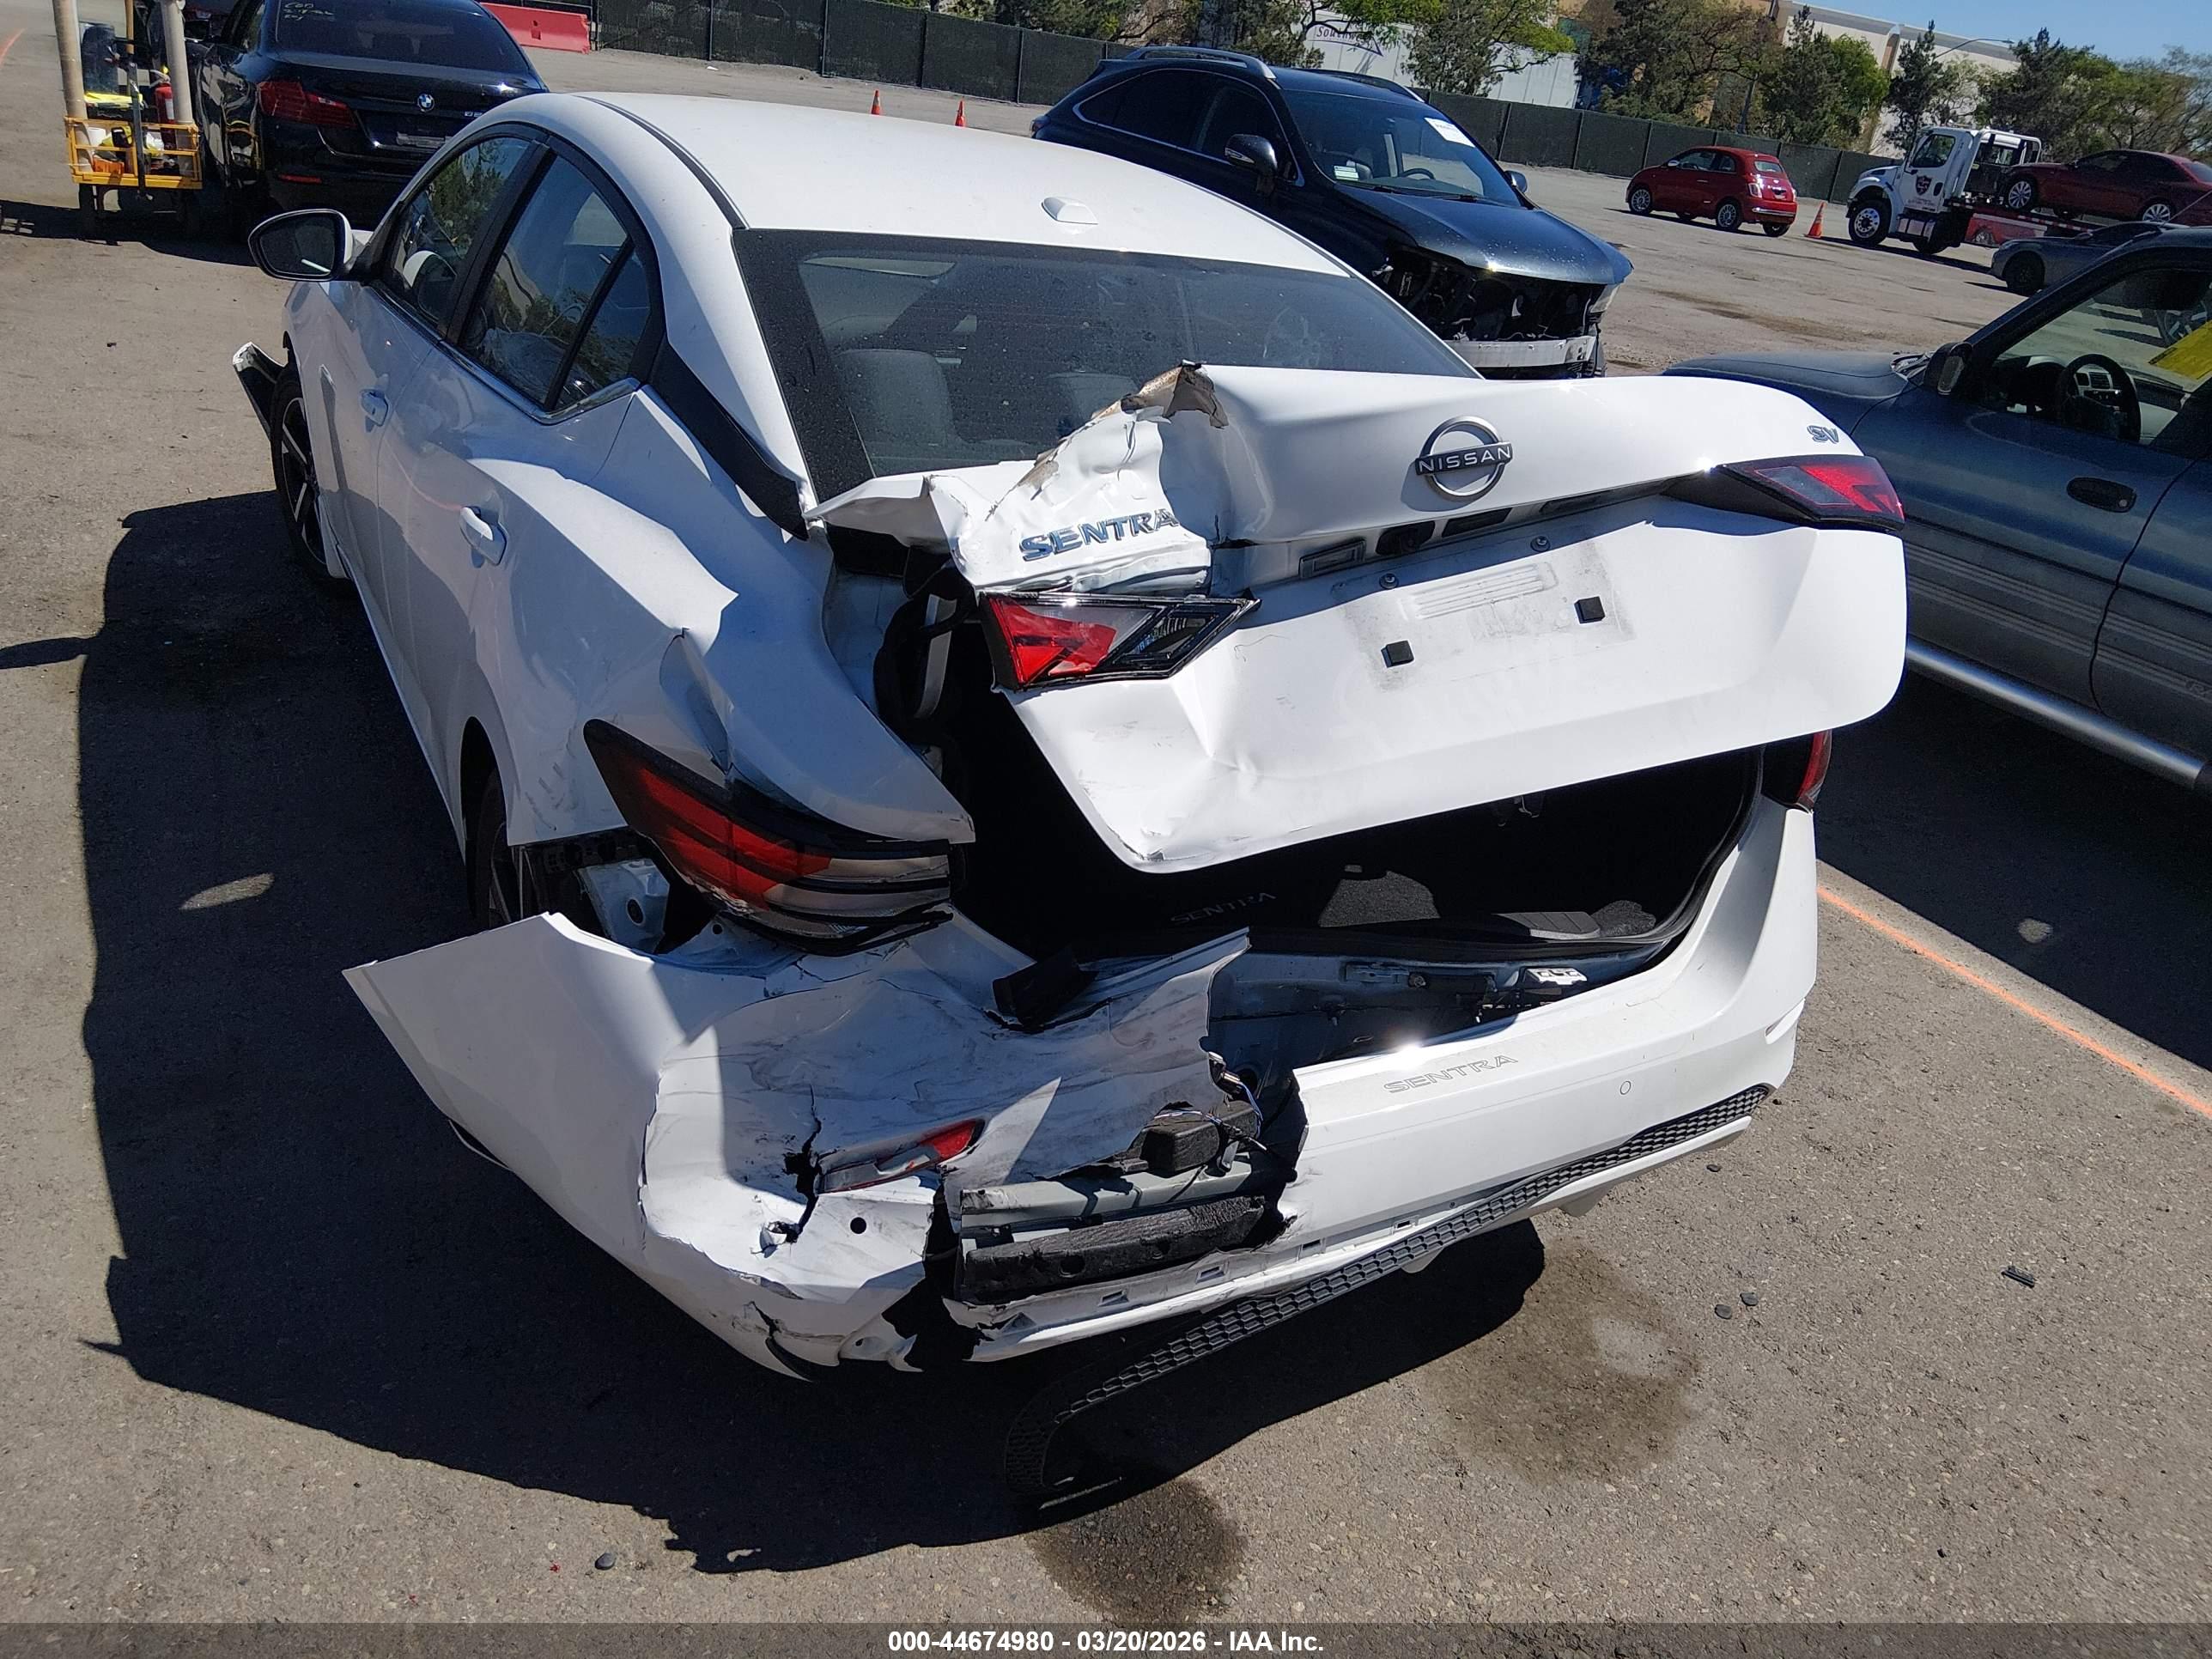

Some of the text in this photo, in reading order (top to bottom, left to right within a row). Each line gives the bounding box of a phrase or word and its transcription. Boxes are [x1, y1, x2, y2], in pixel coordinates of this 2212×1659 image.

[1807, 425, 1839, 444] SV
[1419, 446, 1511, 472] NISSAN
[1018, 508, 1180, 562] SENTRA
[1383, 1055, 1519, 1094] SENTRA
